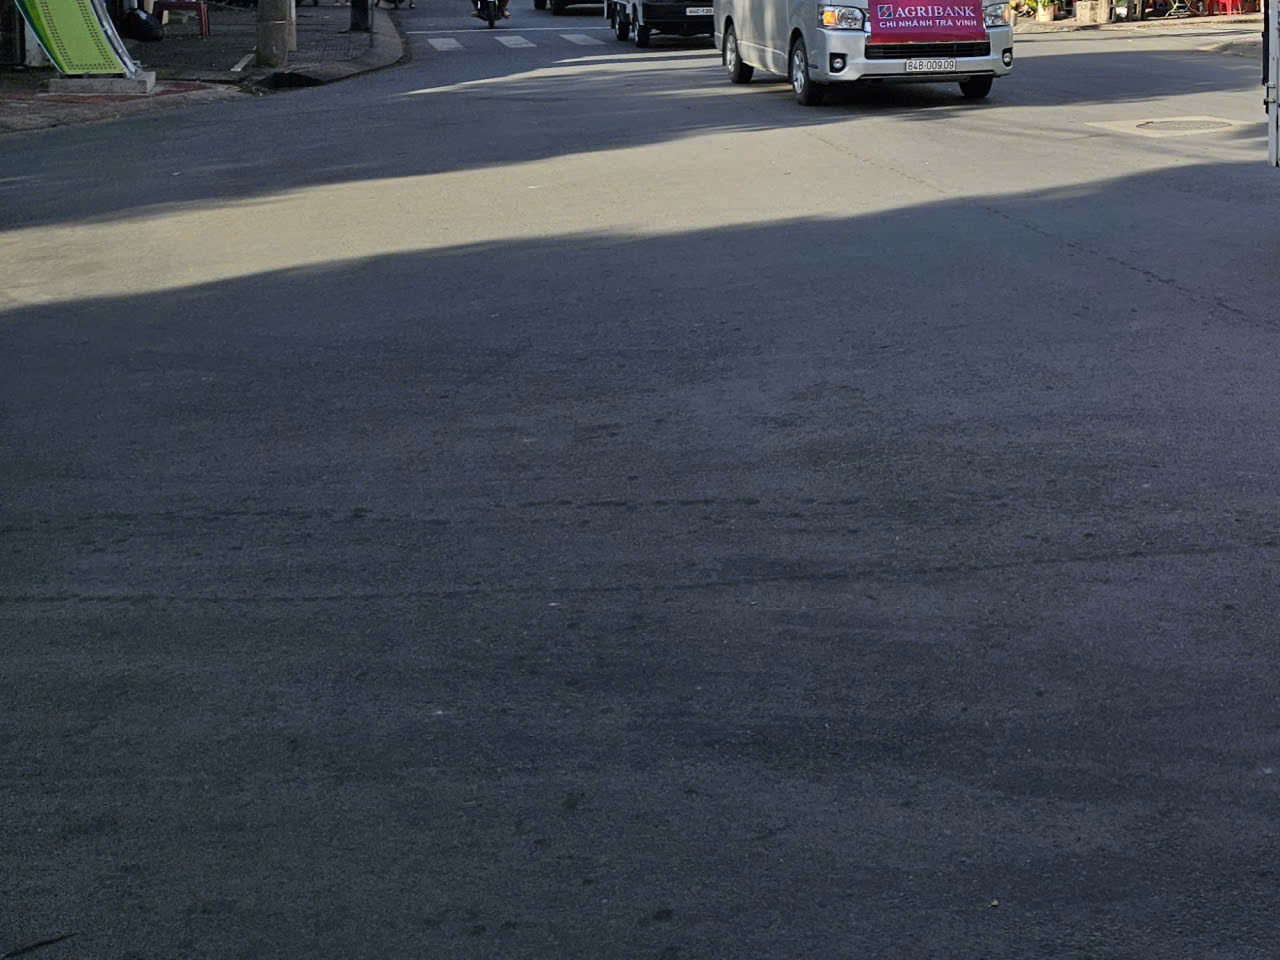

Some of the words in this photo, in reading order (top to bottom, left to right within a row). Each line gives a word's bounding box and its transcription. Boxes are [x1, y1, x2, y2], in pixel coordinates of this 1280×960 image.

[895, 5, 976, 18] AGRIBANK
[880, 20, 897, 28] CHI
[899, 19, 933, 27] NHÁNH
[955, 19, 977, 27] VINH
